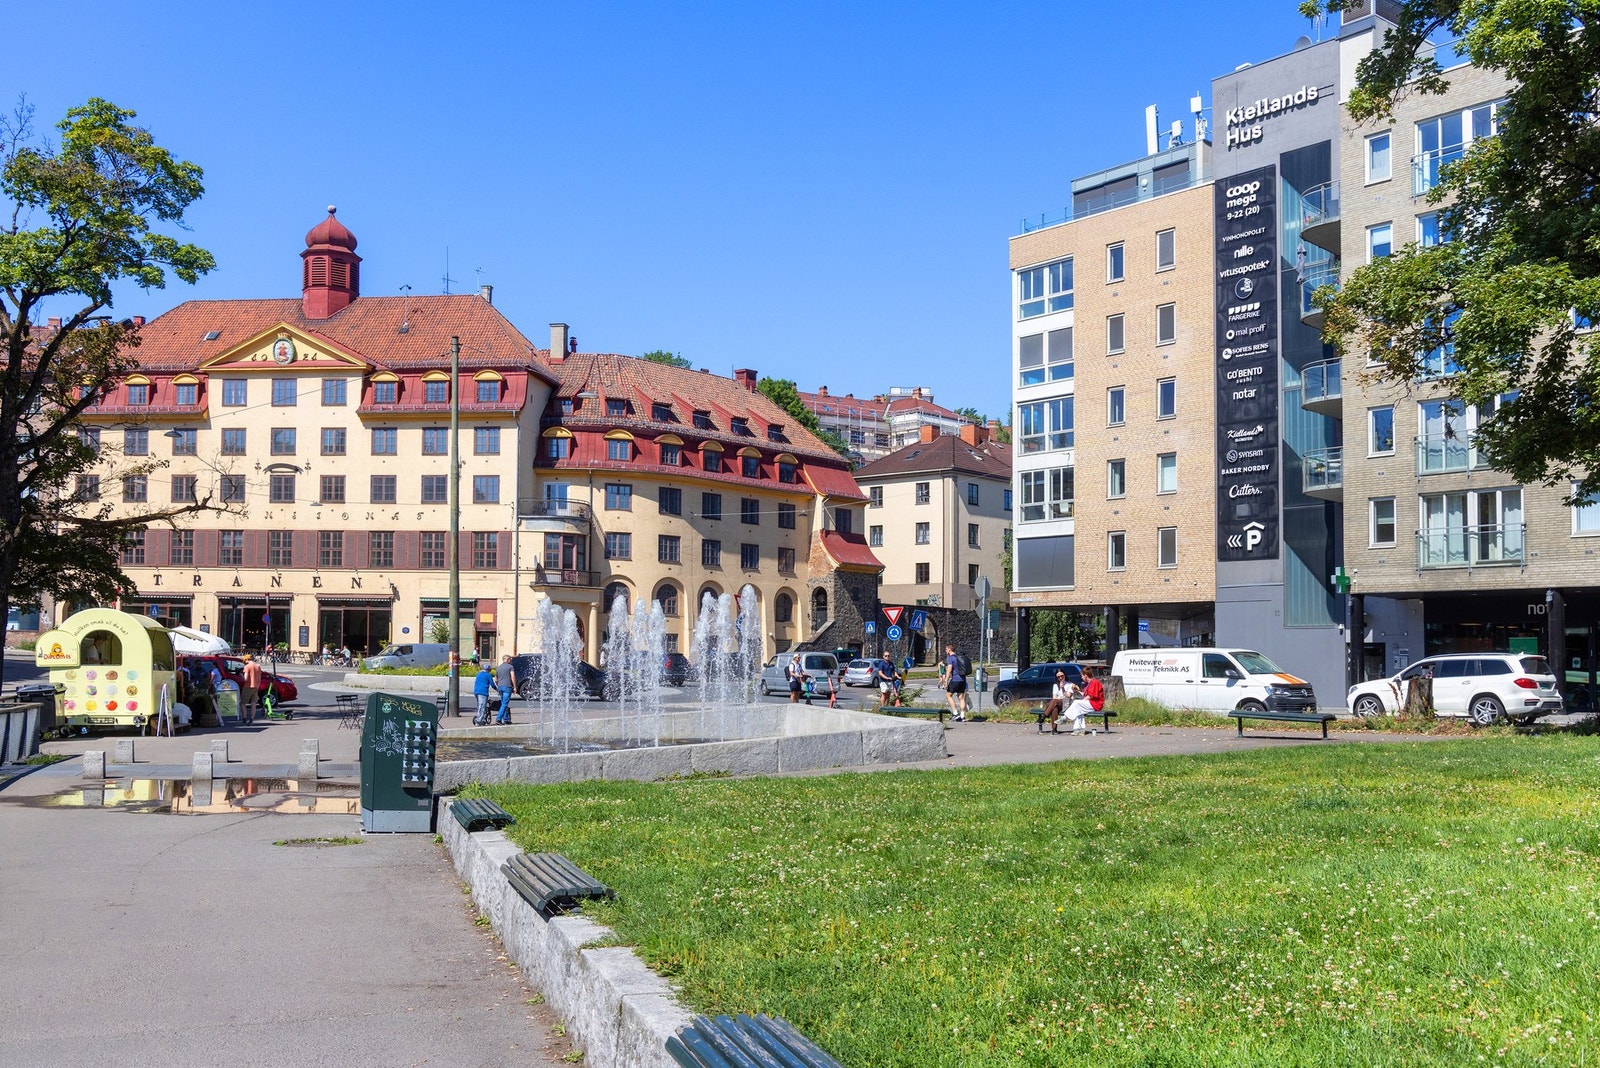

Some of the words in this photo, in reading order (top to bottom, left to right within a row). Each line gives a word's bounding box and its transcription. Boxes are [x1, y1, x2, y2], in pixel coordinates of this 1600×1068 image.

[1226, 85, 1318, 126] Kiellands
[1226, 126, 1262, 147] Hus
[1226, 180, 1260, 198] coop
[1226, 195, 1257, 209] mega
[1227, 209, 1243, 221] 9-22
[1245, 204, 1260, 217] (20)
[1222, 227, 1266, 242] VINMONOPOLET
[1234, 245, 1254, 259] nille
[1228, 310, 1260, 322] FARGERIKE
[1235, 327, 1248, 336] mal
[1249, 323, 1266, 336] proff
[1232, 346, 1252, 354] SOFIES
[1253, 343, 1269, 351] RENS
[1233, 388, 1257, 400] notar
[1221, 467, 1242, 475] BAKER
[1243, 464, 1270, 473] NORDBY
[1246, 529, 1262, 551] P
[154, 575, 361, 589] TRANEN
[1528, 604, 1550, 615] not
